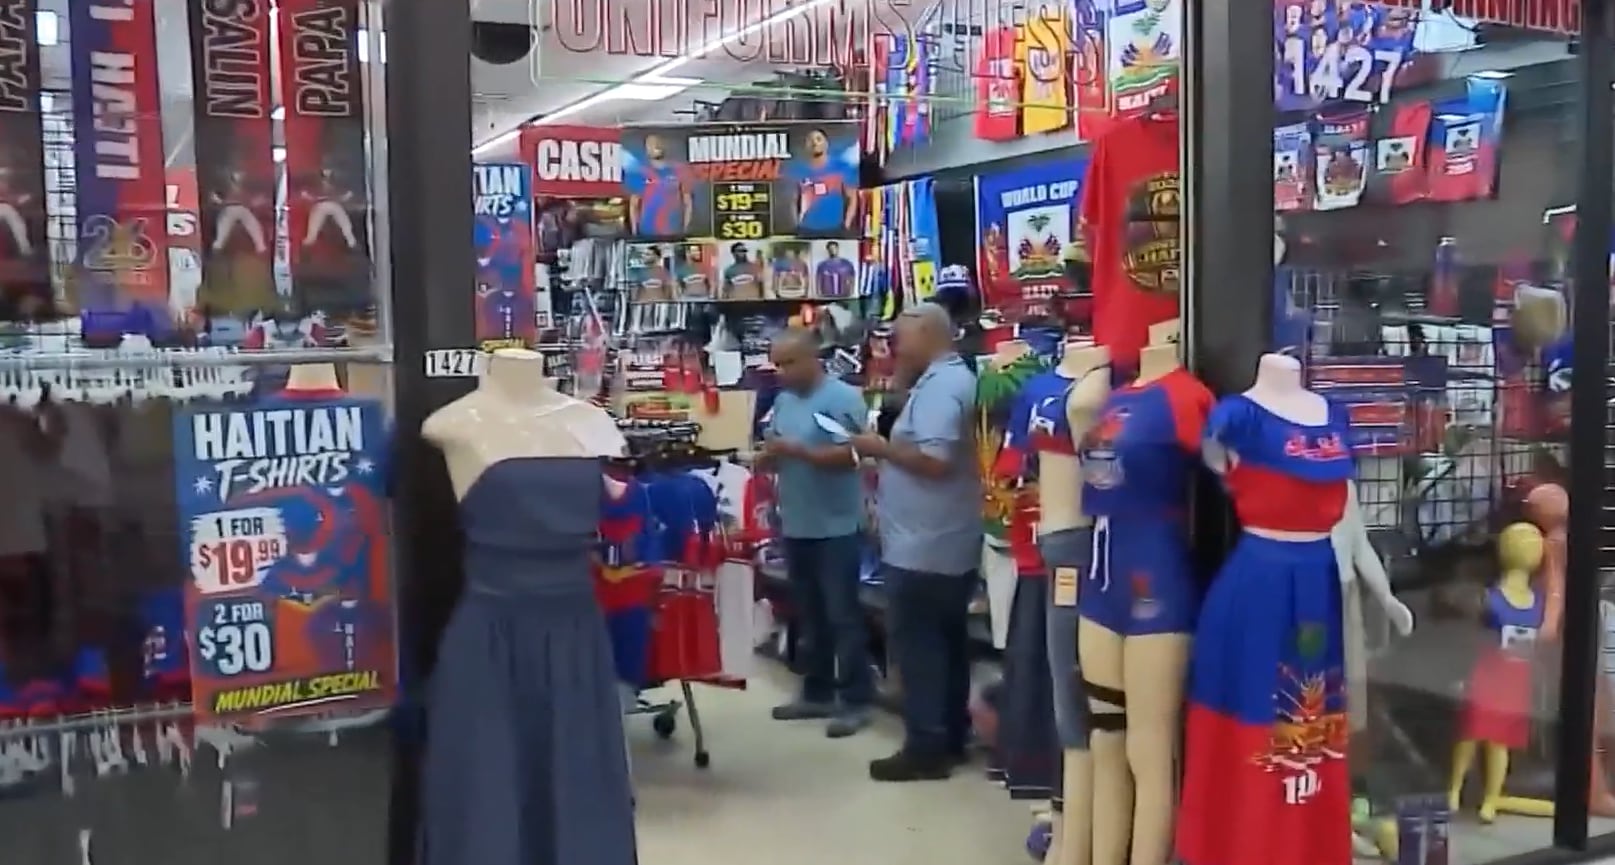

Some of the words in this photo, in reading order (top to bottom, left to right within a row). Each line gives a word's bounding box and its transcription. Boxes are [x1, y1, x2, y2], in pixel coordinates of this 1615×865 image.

[1283, 38, 1403, 104] 1427
[90, 51, 141, 180] HAITI
[537, 138, 622, 183] CASH
[689, 133, 792, 163] MUNDIAL
[1001, 182, 1048, 209] WORLD
[1050, 180, 1079, 200] CUP
[722, 221, 763, 239] $30
[427, 350, 477, 375] 1427
[192, 406, 365, 461] HAITIAN
[214, 452, 351, 504] T-SHIRTS
[216, 518, 225, 538] 1
[231, 516, 265, 535] FOR
[214, 603, 228, 624] 2
[232, 602, 264, 622] FOR
[199, 622, 274, 676] $30
[215, 682, 302, 714] MUNDIAL
[305, 669, 381, 697] SPECIAL
